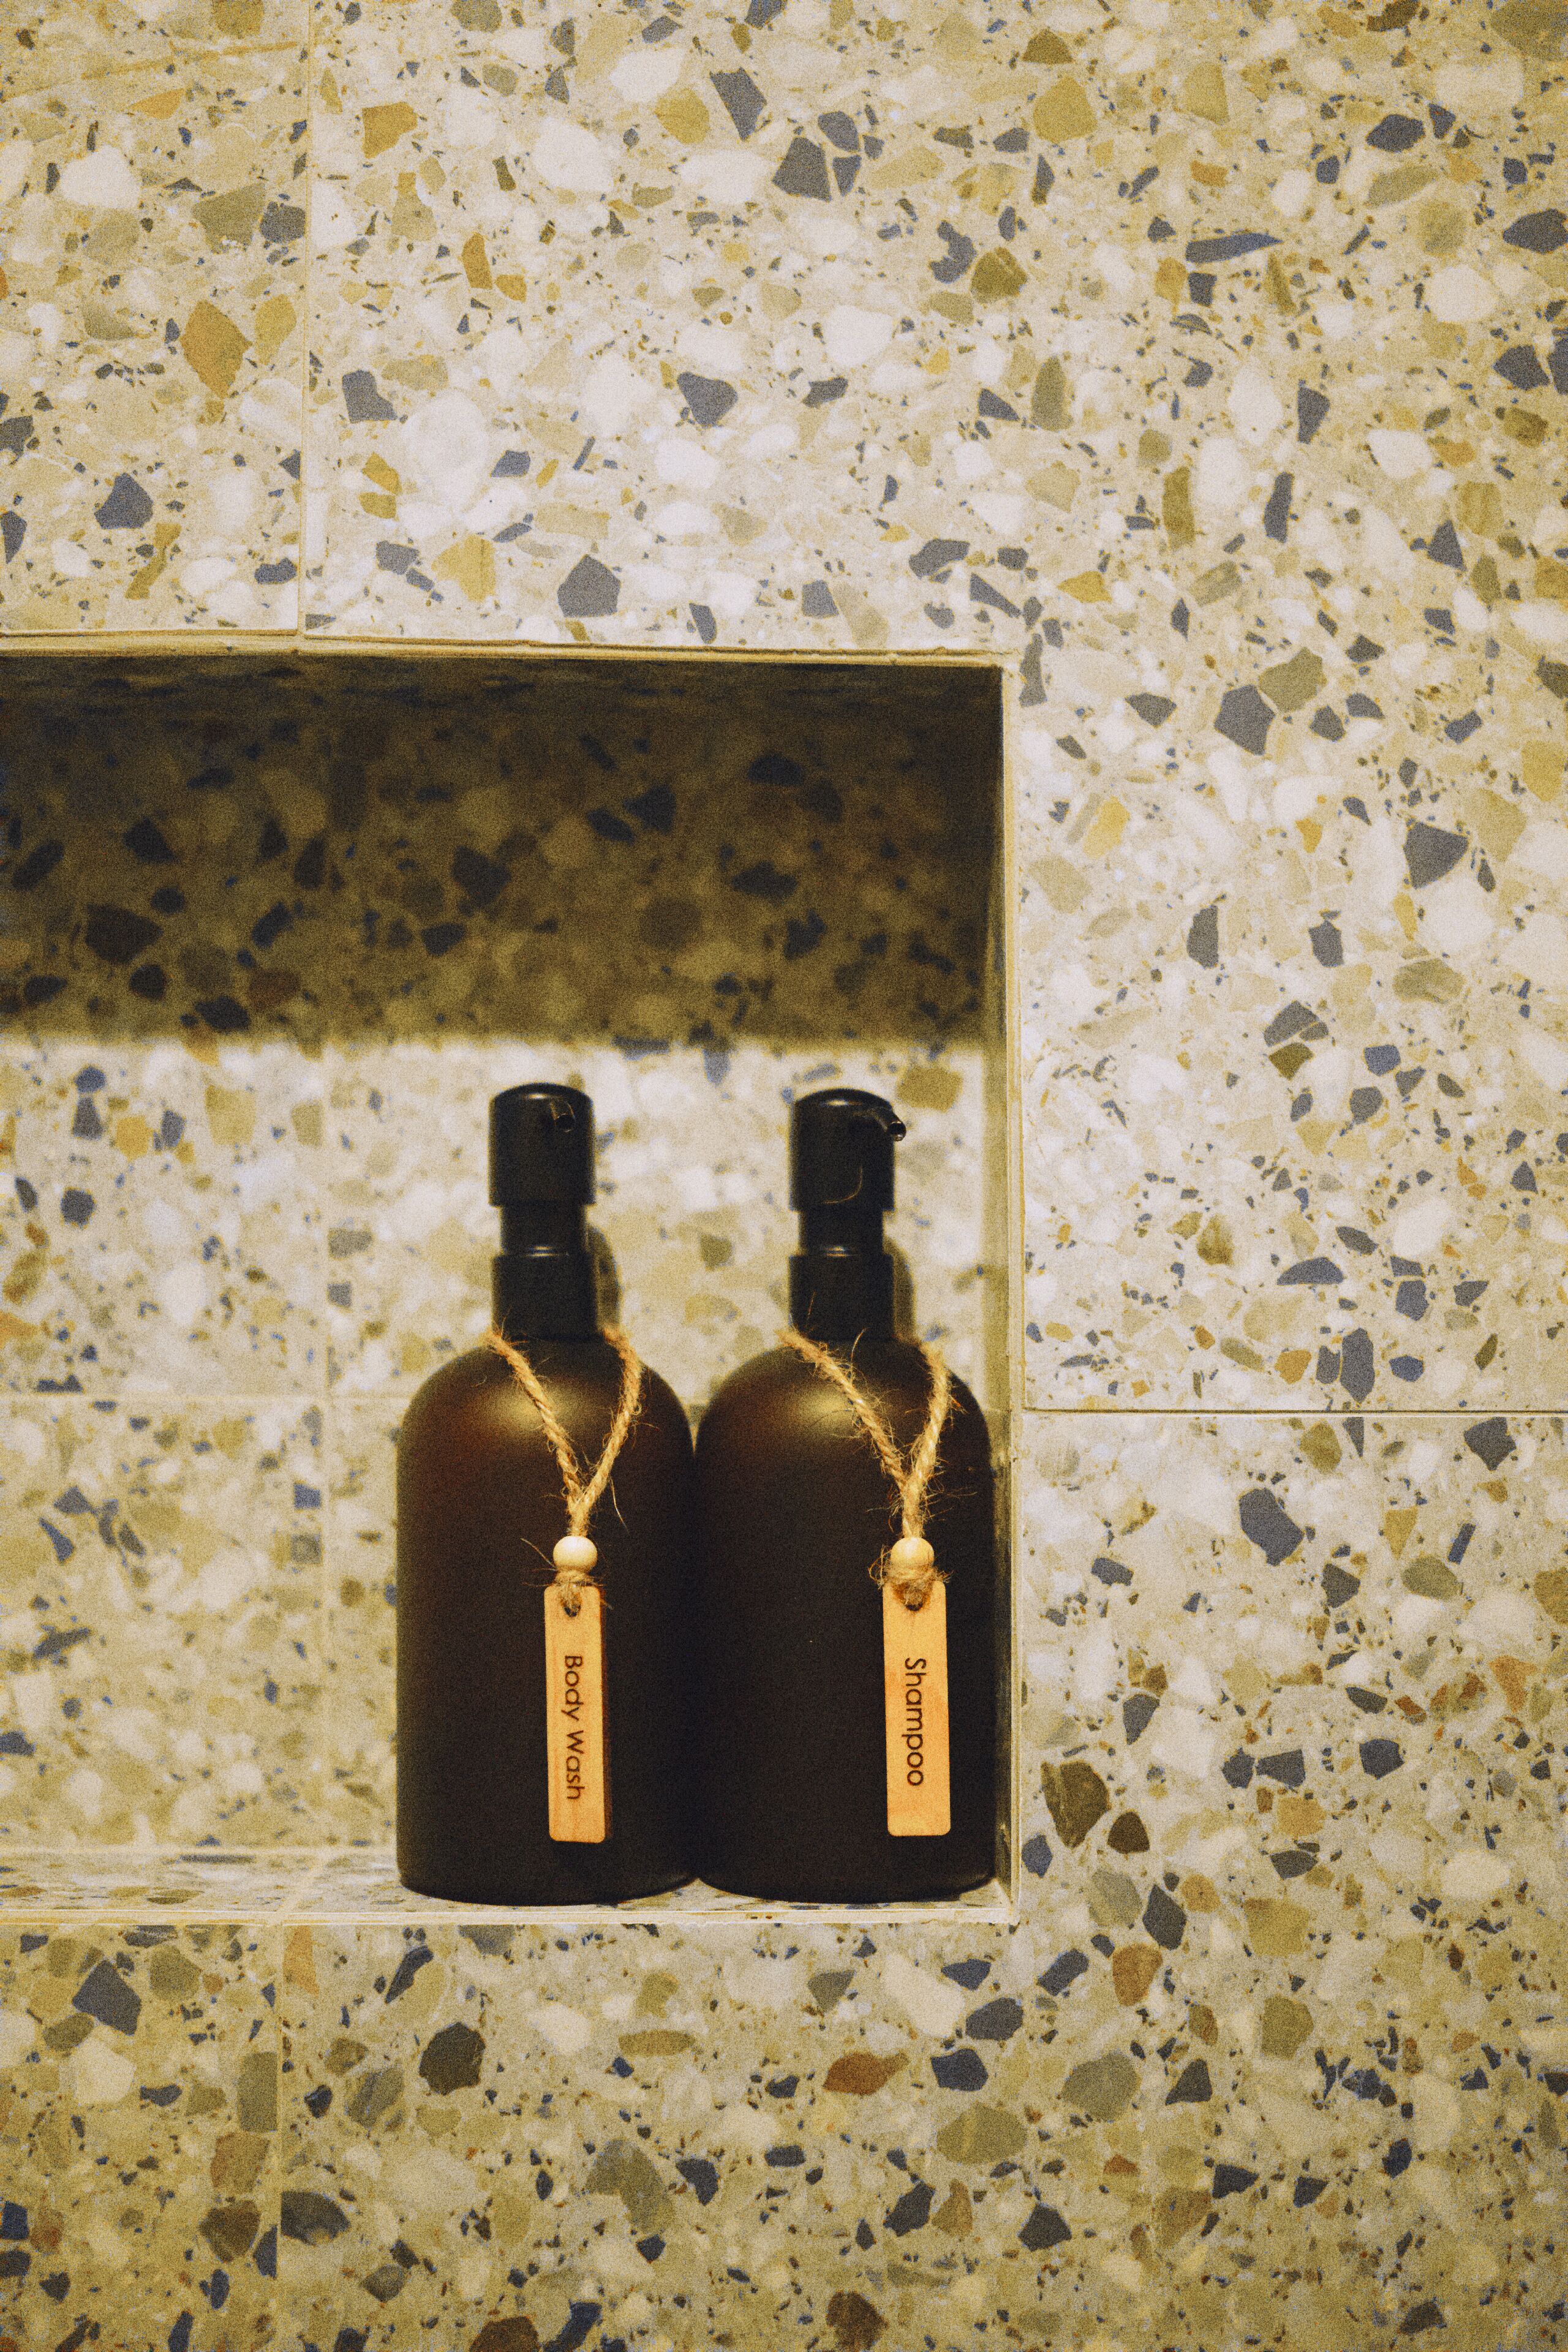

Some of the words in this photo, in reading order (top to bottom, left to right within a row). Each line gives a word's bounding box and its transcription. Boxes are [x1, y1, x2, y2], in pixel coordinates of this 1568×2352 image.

[561, 1655, 584, 1721] Body
[902, 1657, 927, 1786] Shampoo
[566, 1730, 585, 1800] Wash
